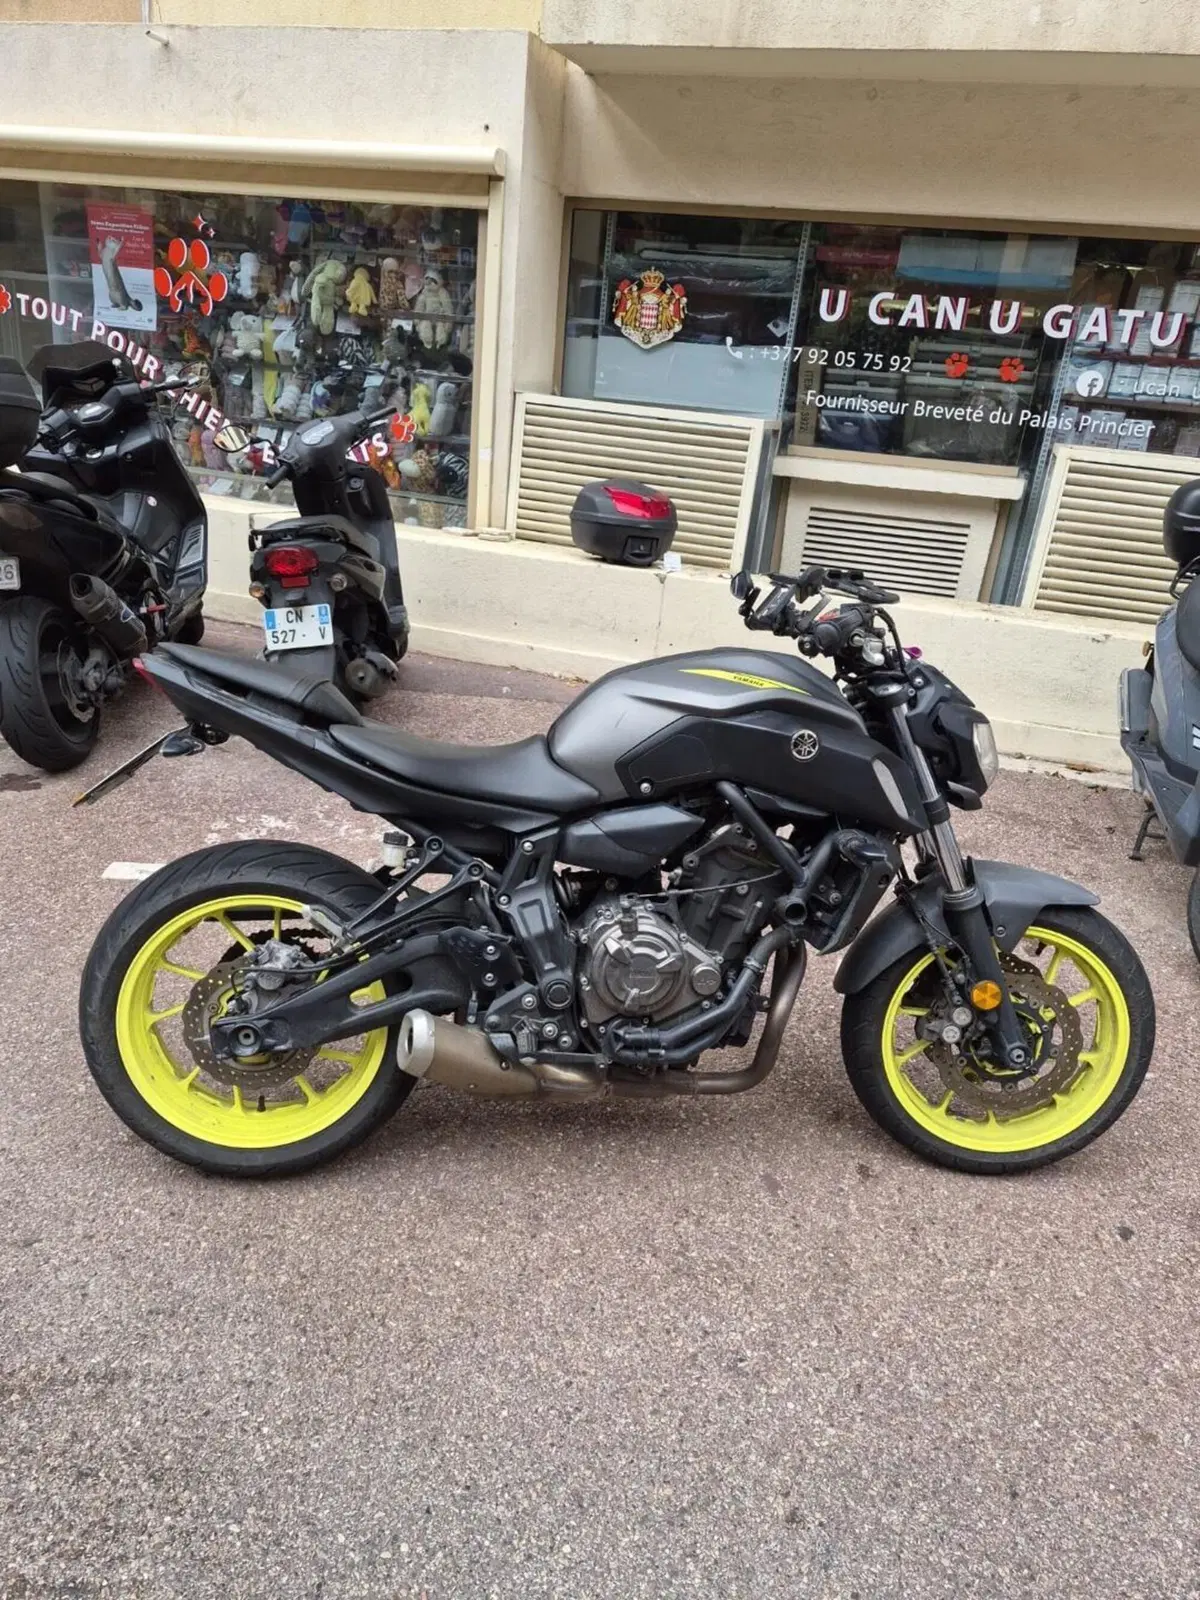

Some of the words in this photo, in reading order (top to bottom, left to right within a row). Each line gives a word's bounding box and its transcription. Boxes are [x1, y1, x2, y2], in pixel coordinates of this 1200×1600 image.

[819, 288, 848, 322] U
[868, 291, 967, 331] CAN
[989, 300, 1021, 335] U
[1043, 303, 1184, 347] GATU
[16, 292, 83, 332] TOUT
[90, 319, 159, 380] POUR
[760, 345, 803, 362] +377
[807, 348, 828, 365] 92
[834, 350, 856, 368] 05
[862, 352, 883, 370] 75
[889, 355, 912, 373] 92
[1133, 381, 1180, 397] ucan
[806, 390, 909, 415] Fournisseur
[913, 400, 984, 422] Breveté
[989, 406, 1013, 425] du
[1018, 409, 1073, 431] Palais
[1078, 415, 1156, 437] Princier
[286, 609, 304, 624] CN
[271, 629, 296, 645] 527
[318, 626, 326, 640] V
